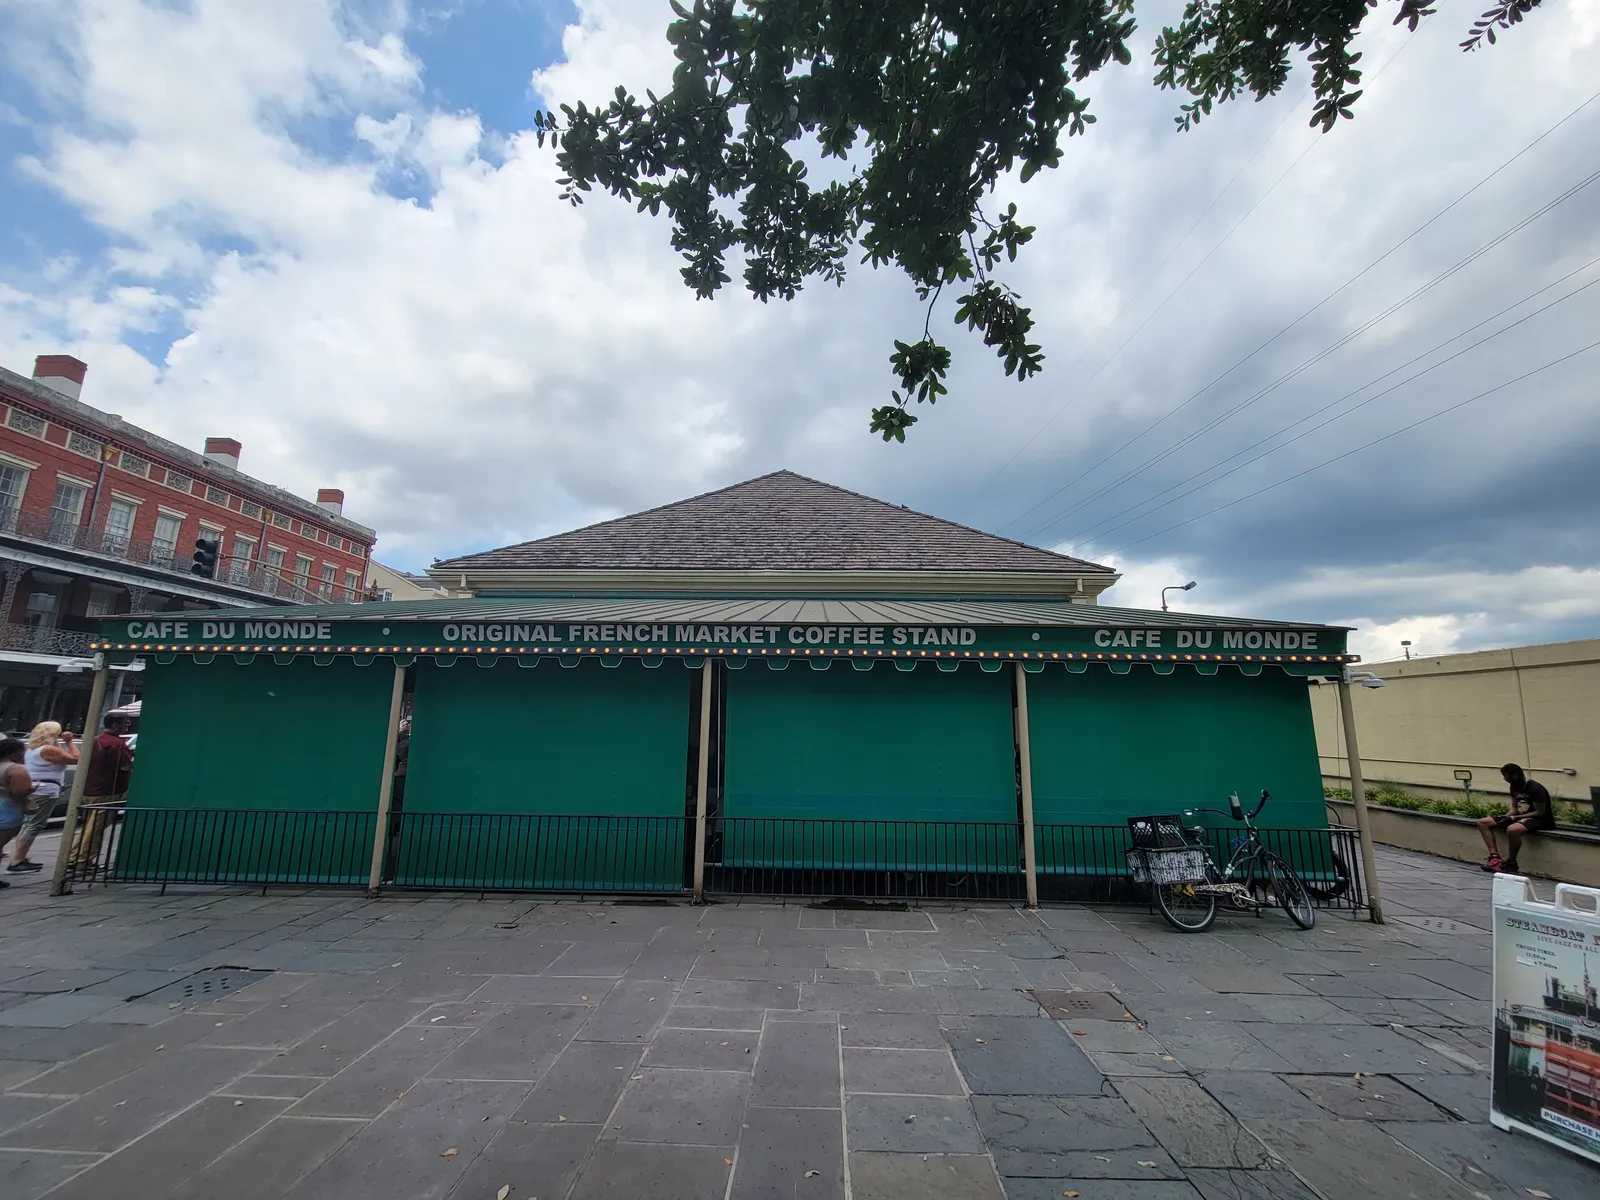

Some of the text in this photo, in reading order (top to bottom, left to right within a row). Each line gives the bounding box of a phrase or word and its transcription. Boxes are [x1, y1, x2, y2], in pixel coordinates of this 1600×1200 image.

[127, 621, 332, 640] CAFE DU MONDE
[442, 624, 977, 646] ORIGINAL FRENCH MARKET COFFEE STAND
[1094, 629, 1318, 650] CAFE DU MONDE
[1506, 917, 1585, 943] STEAMBOAT
[1537, 935, 1553, 944] LIVE
[1554, 938, 1572, 948] JAZZ
[1544, 1111, 1593, 1136] PURCHASE
